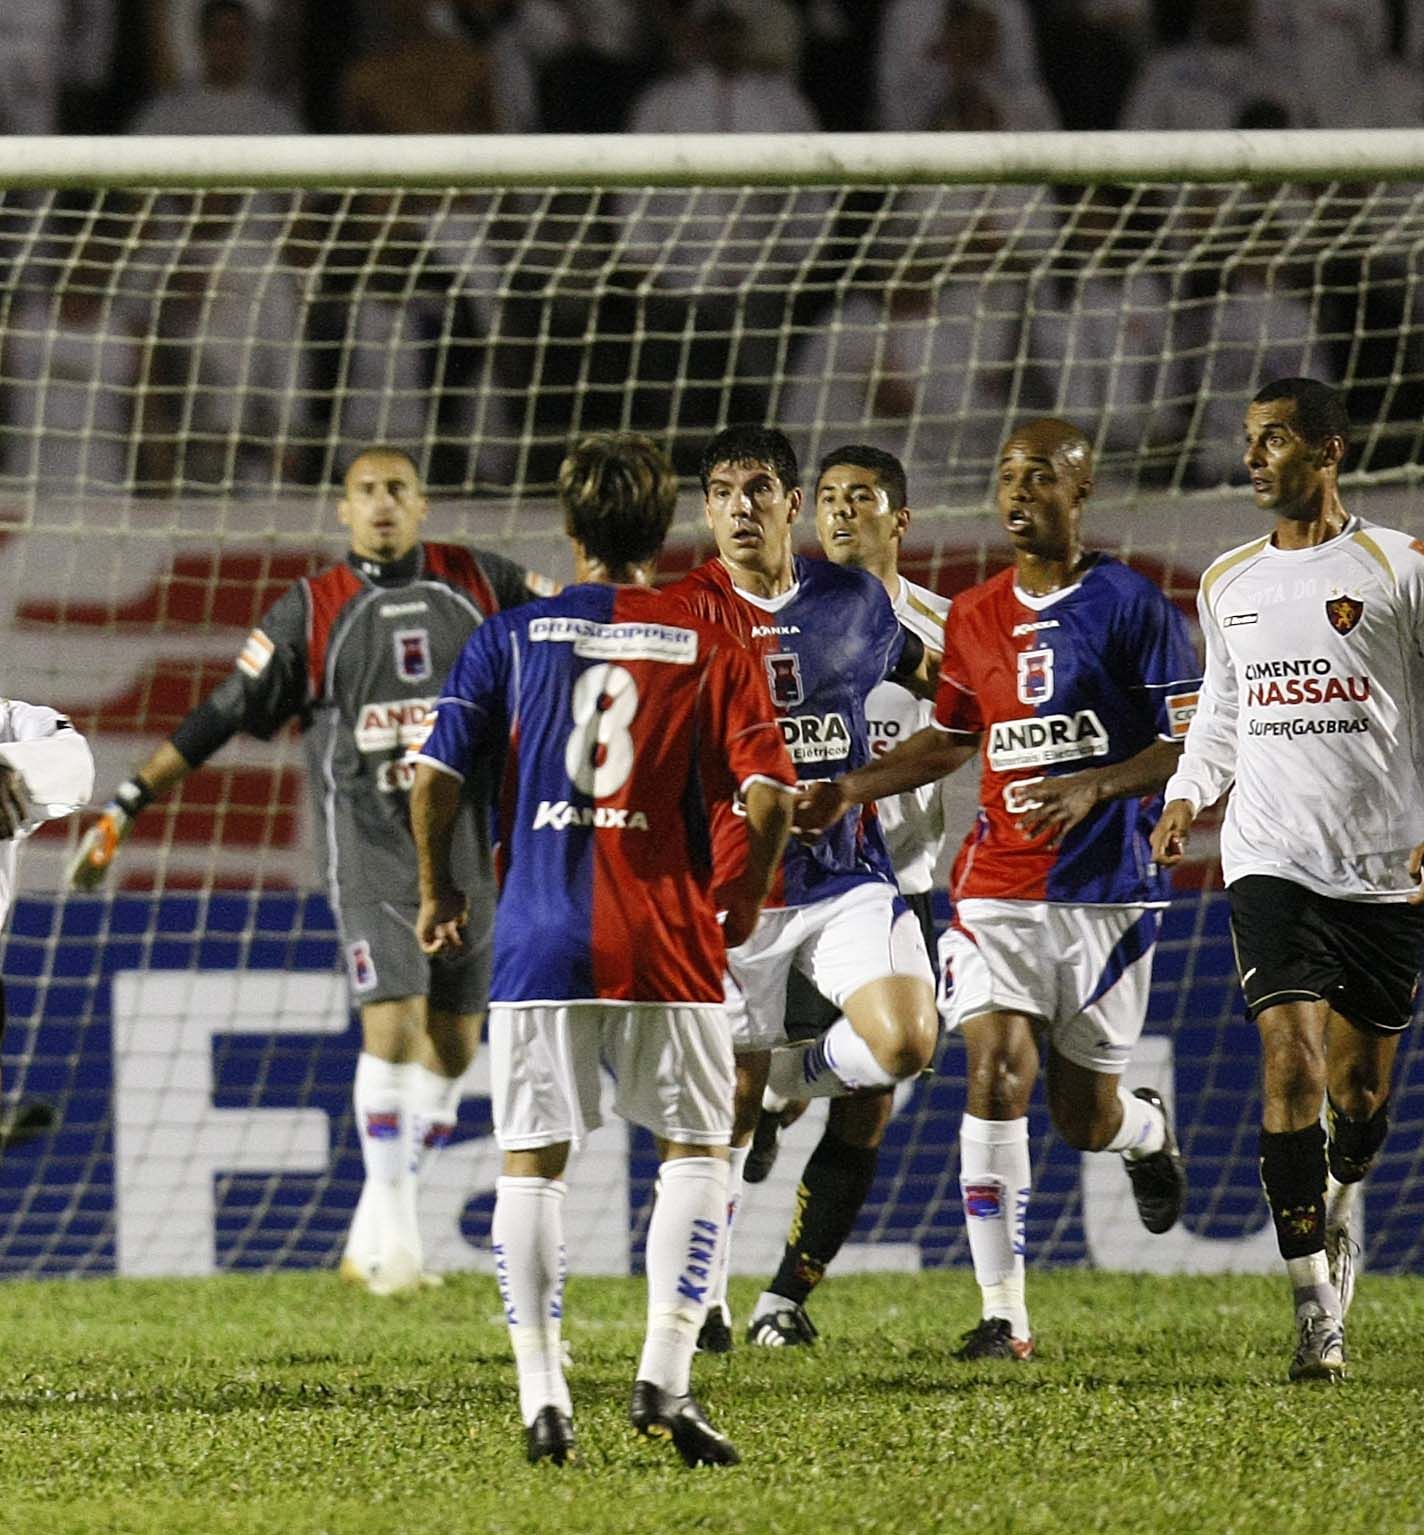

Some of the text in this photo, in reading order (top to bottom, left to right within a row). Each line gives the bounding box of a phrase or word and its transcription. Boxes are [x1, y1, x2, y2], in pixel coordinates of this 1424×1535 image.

[1246, 659, 1331, 680] CIMENTO
[1248, 677, 1371, 707] NASSAU
[565, 663, 638, 798] 8
[778, 717, 847, 745] DRA
[994, 715, 1091, 753] ANDRA
[533, 801, 649, 830] KANXA
[677, 1218, 719, 1304] KANXA
